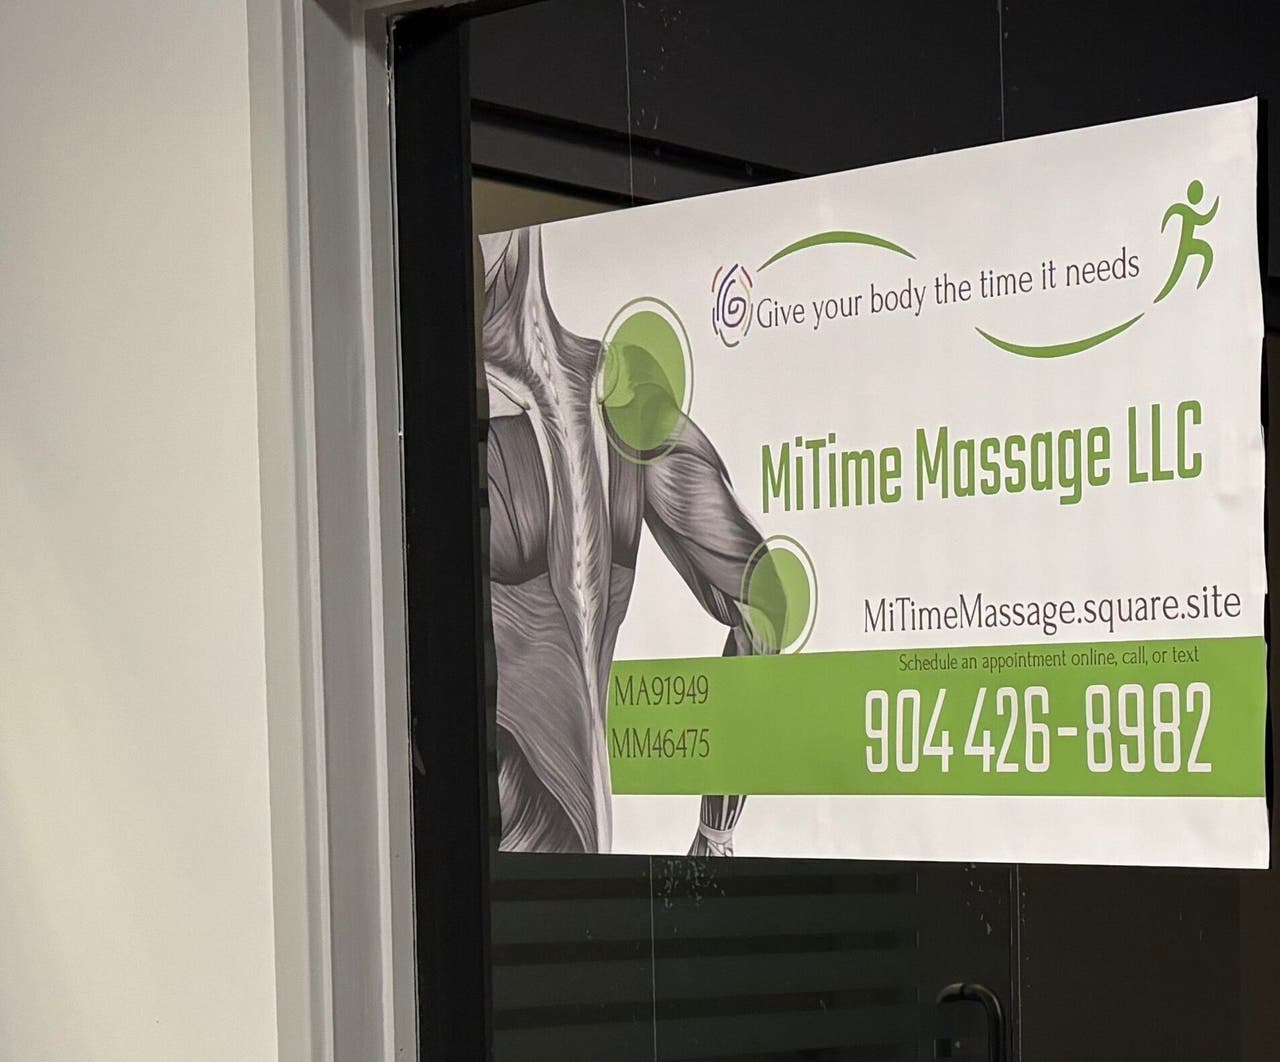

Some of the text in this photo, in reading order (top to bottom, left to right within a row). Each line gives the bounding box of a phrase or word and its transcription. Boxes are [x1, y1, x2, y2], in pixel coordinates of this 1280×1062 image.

[757, 246, 1140, 330] Give your body the time it needs
[761, 400, 1202, 514] MiTime Massage LLC
[863, 584, 1242, 636] MiTimeMassage.square.site
[898, 646, 1199, 674] Schedule an appointment online, call, or text
[615, 674, 709, 706] MA91949
[611, 727, 710, 759] MM46475
[865, 682, 1212, 773] 904 426-8982
